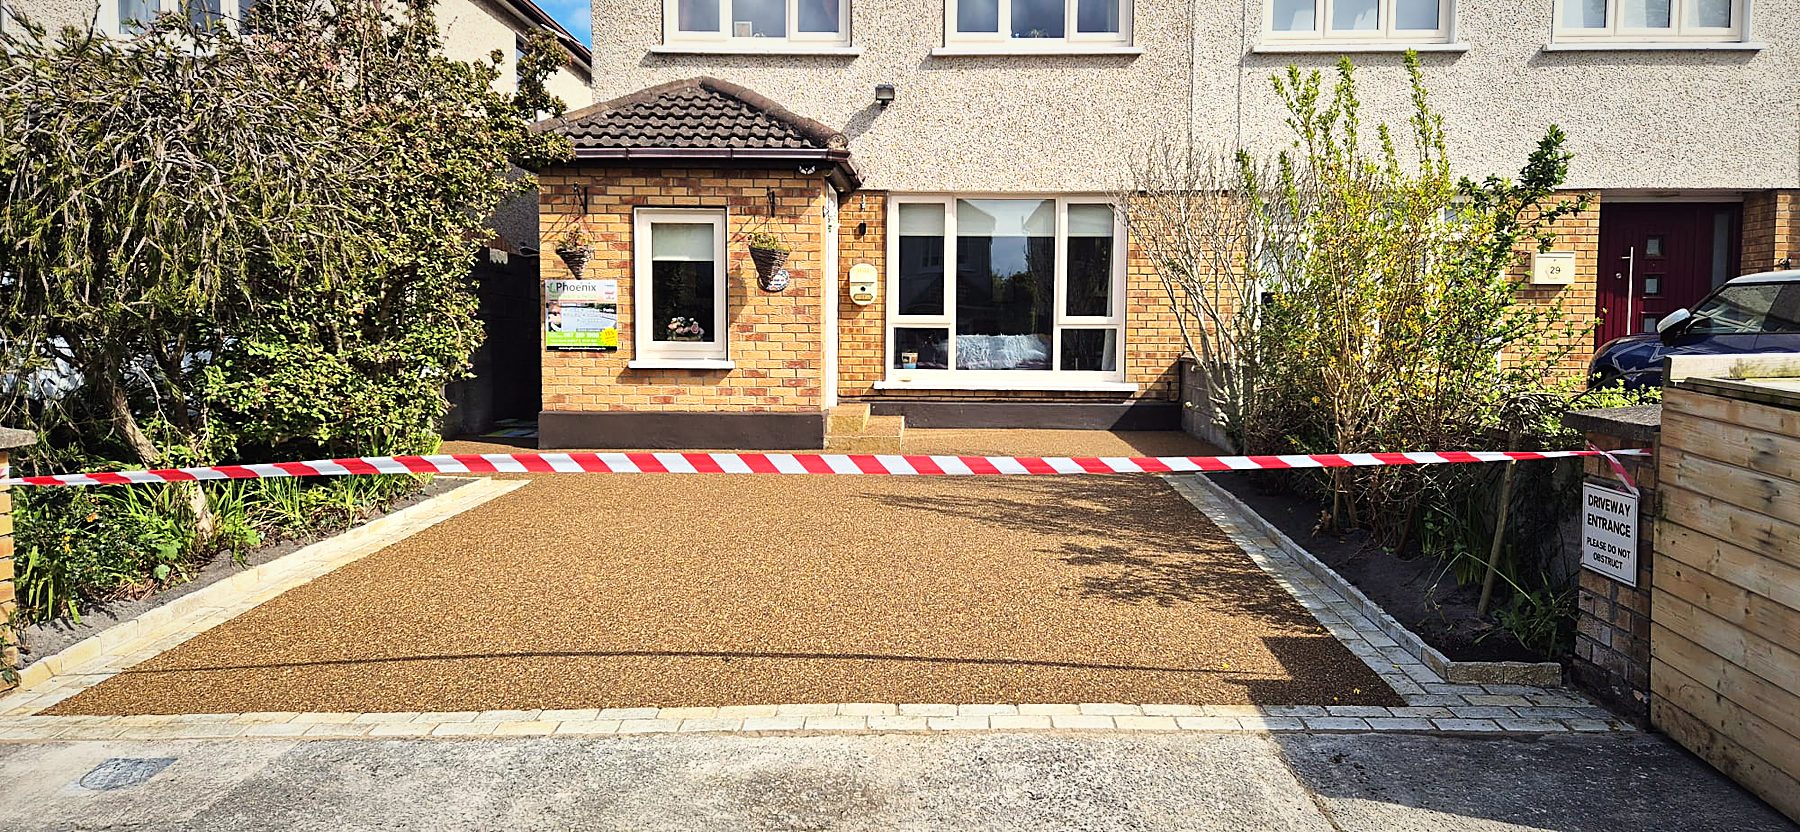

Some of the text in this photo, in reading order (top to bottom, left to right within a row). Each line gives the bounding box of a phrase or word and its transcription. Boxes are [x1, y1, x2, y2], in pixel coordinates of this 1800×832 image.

[1550, 266, 1561, 275] 29
[556, 282, 597, 292] Phoenix
[1587, 494, 1631, 517] DRIVEWAY
[1587, 513, 1631, 538] ENTRANCE
[1586, 536, 1631, 559] PLEASE DO NOT
[1592, 552, 1623, 570] OBSTRUCT
